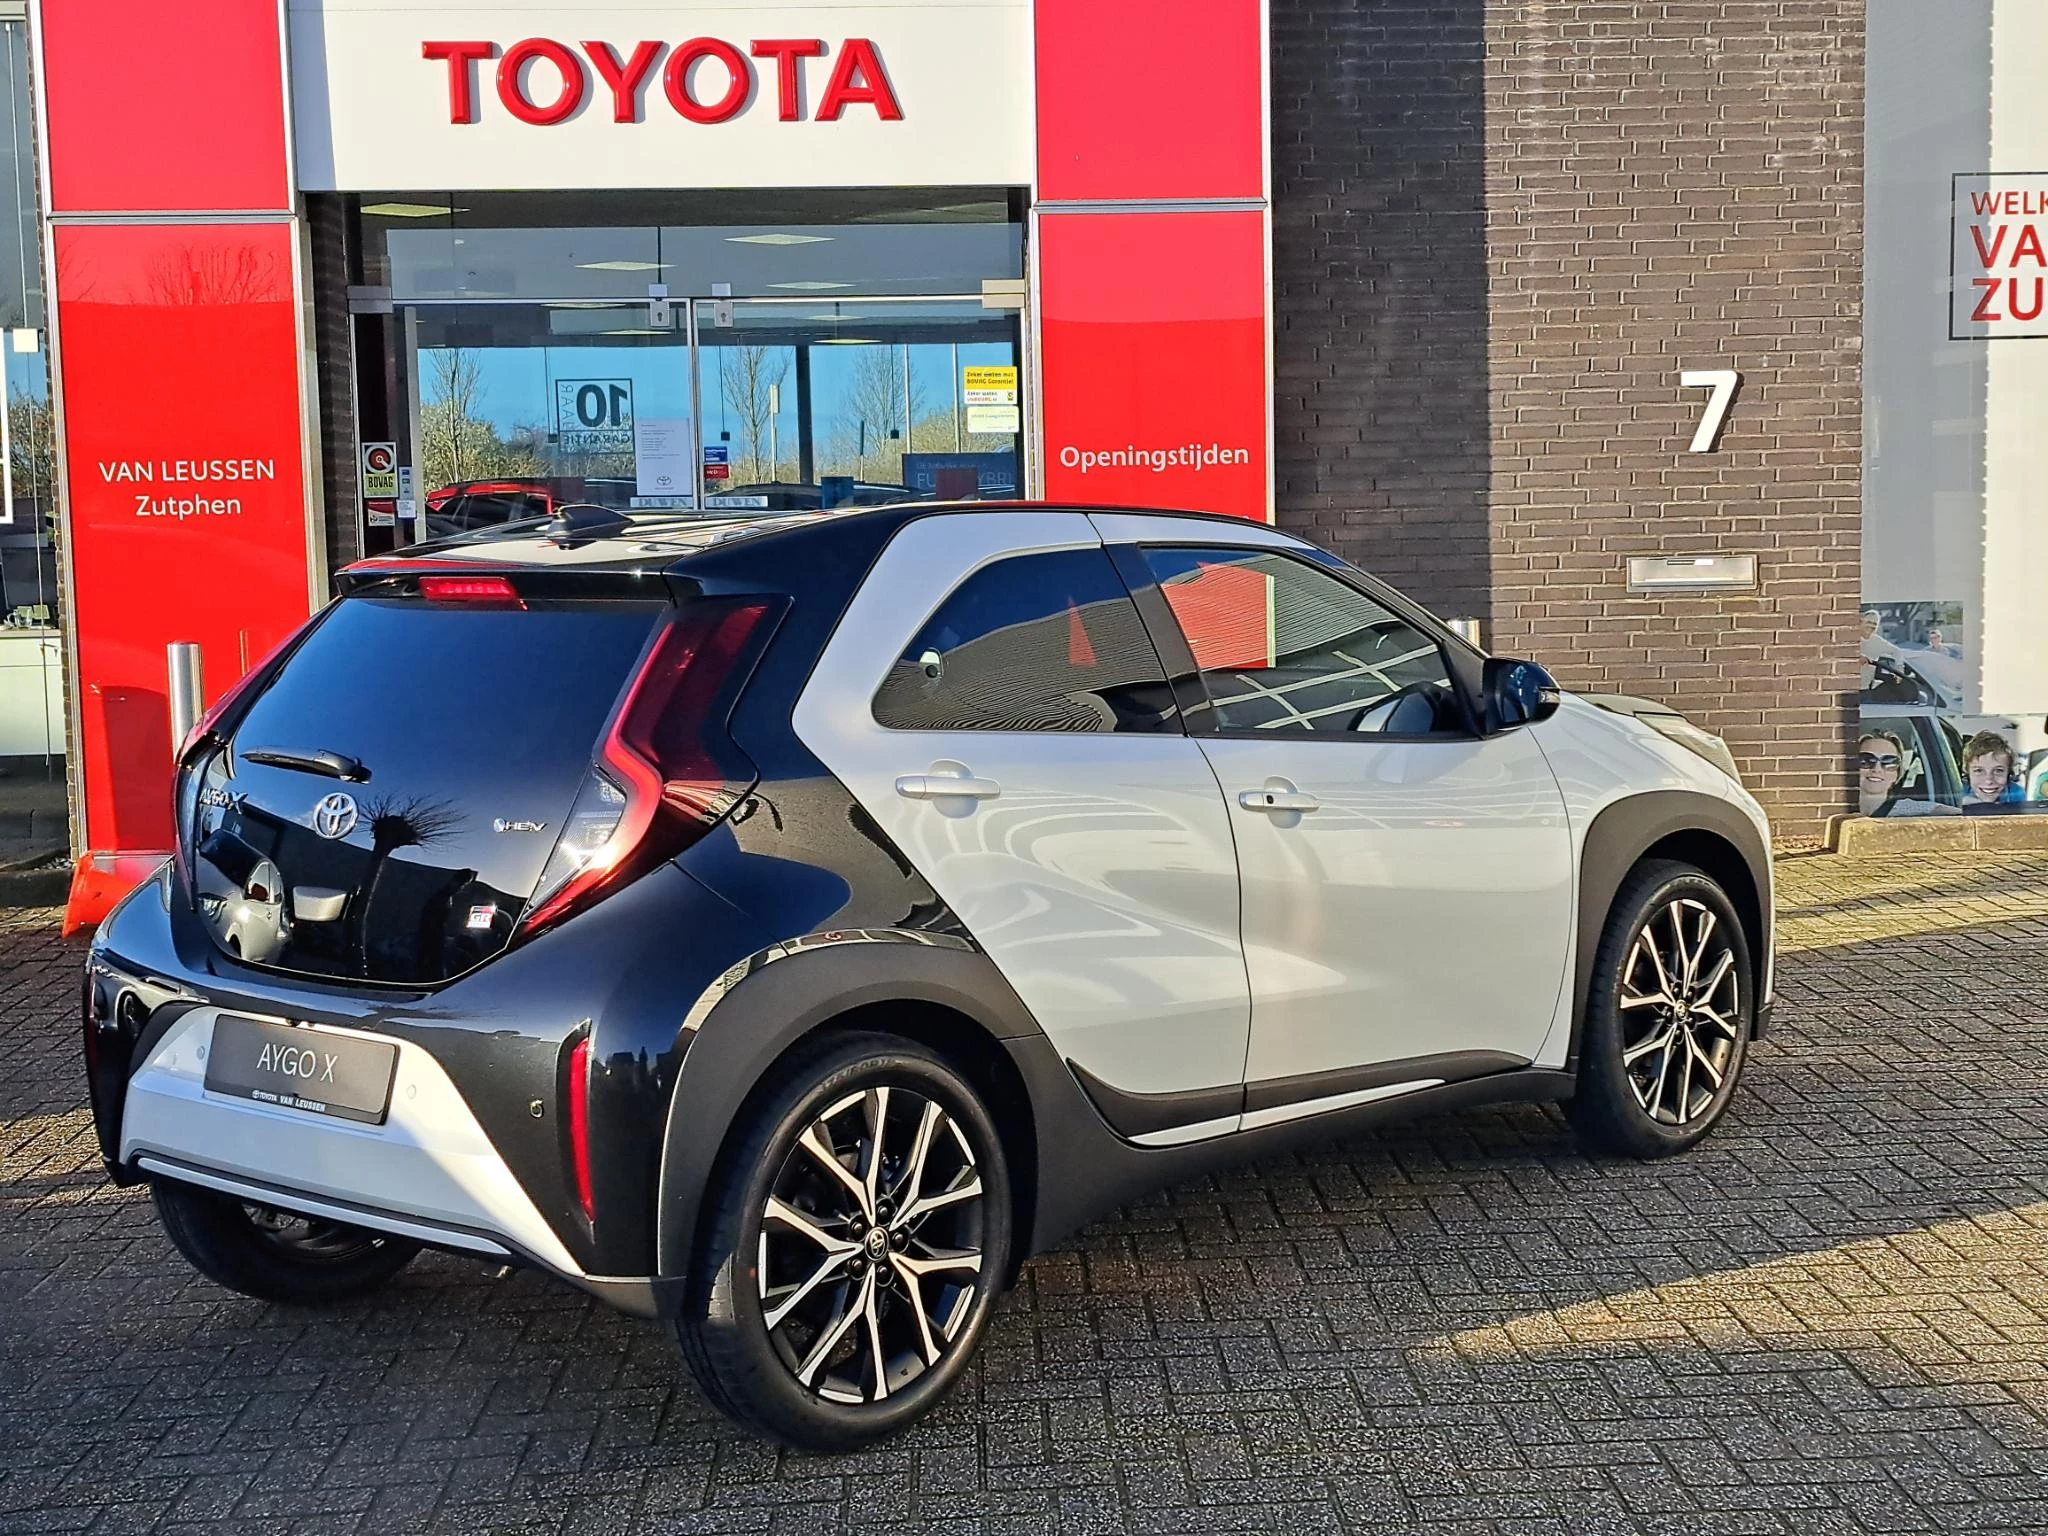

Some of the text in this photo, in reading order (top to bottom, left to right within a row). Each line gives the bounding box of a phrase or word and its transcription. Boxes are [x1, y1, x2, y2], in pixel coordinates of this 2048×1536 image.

[422, 37, 905, 126] TOYOTA
[1970, 225, 2048, 268] VA
[1971, 277, 2044, 321] ZU
[1680, 370, 1737, 453] 7
[99, 459, 275, 482] VAN LEUSSEN
[1059, 444, 1249, 473] Openingstijden
[368, 476, 394, 488] BOVAG
[135, 494, 241, 520] Zutphen
[713, 497, 761, 506] DUWEN
[505, 821, 547, 832] HEV
[256, 1042, 338, 1083] AYGO X
[260, 1092, 326, 1112] TOYOTA VAN LEUSSEN
